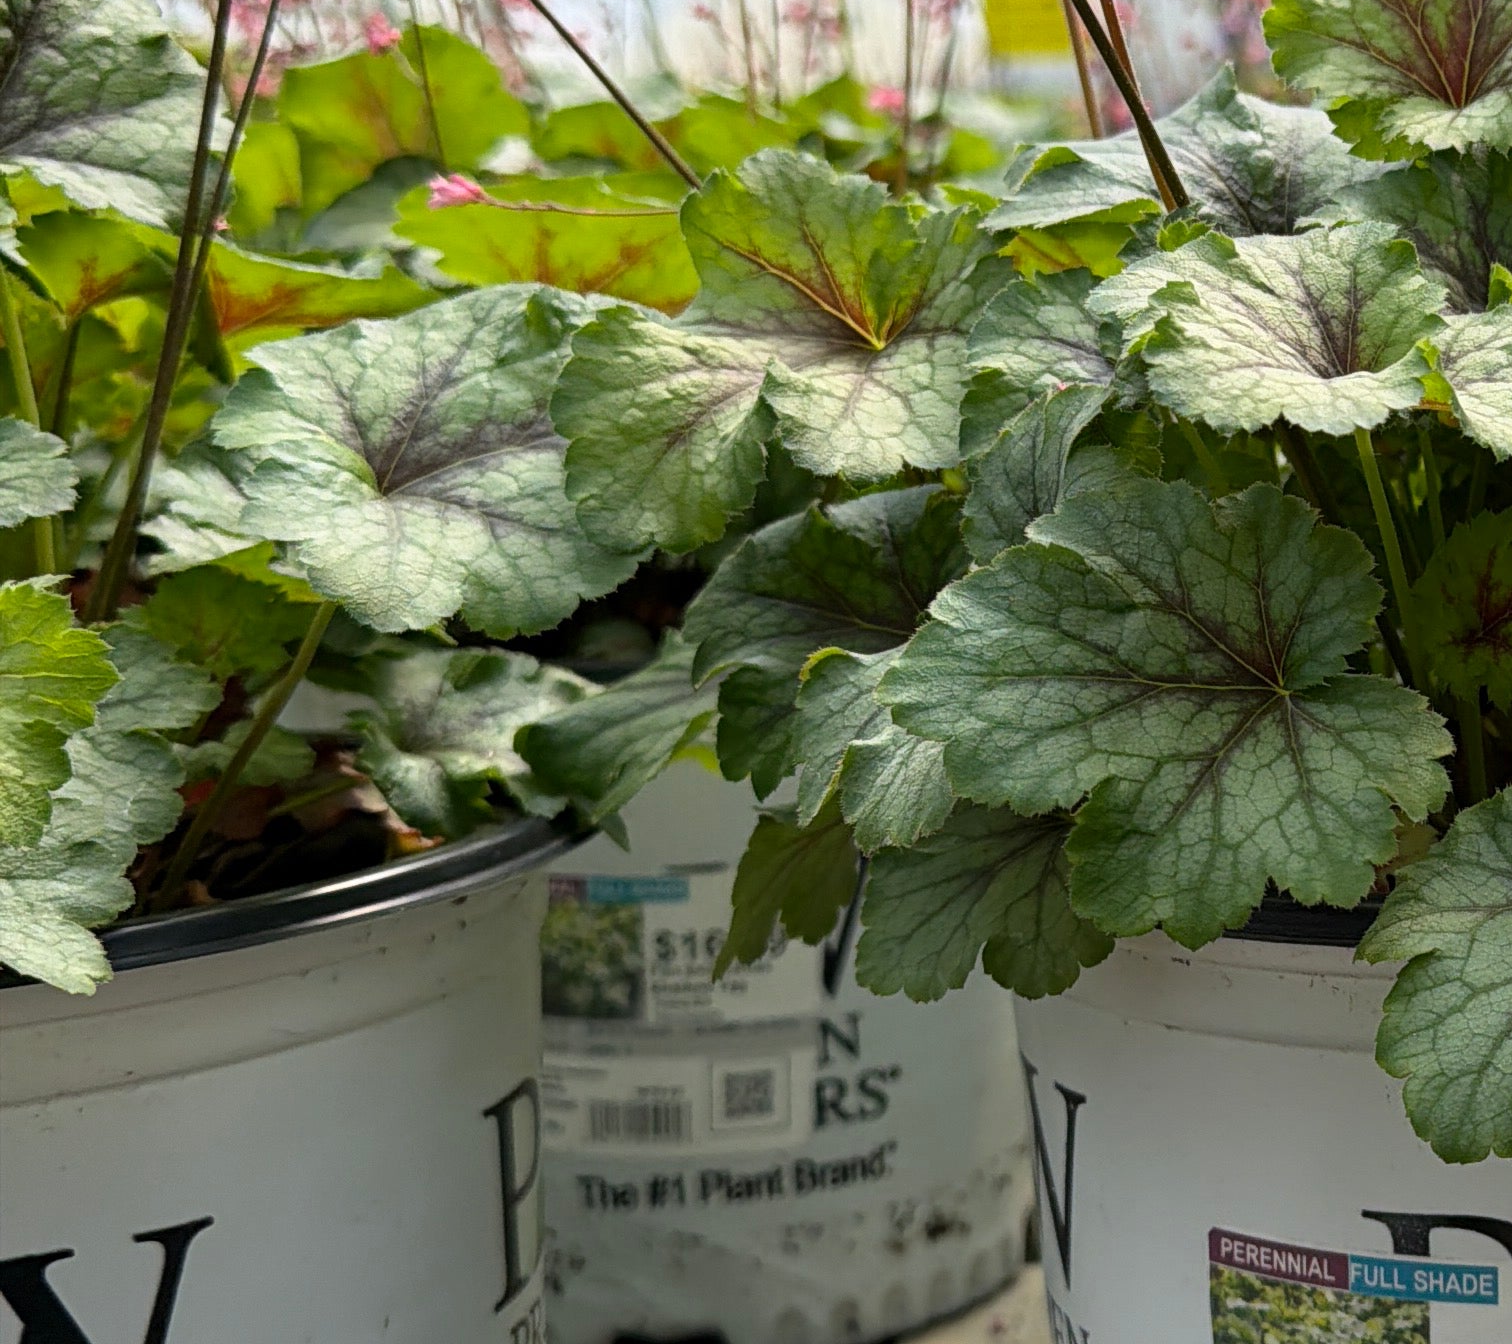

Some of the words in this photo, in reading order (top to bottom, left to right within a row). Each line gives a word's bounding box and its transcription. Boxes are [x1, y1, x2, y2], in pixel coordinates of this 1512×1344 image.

[576, 1173, 638, 1210] The
[648, 1173, 684, 1209] #1
[698, 1168, 784, 1203] Plant
[1220, 1236, 1336, 1283] PERENNIAL
[1350, 1262, 1406, 1291] FULL
[1413, 1269, 1494, 1297] SHADE
